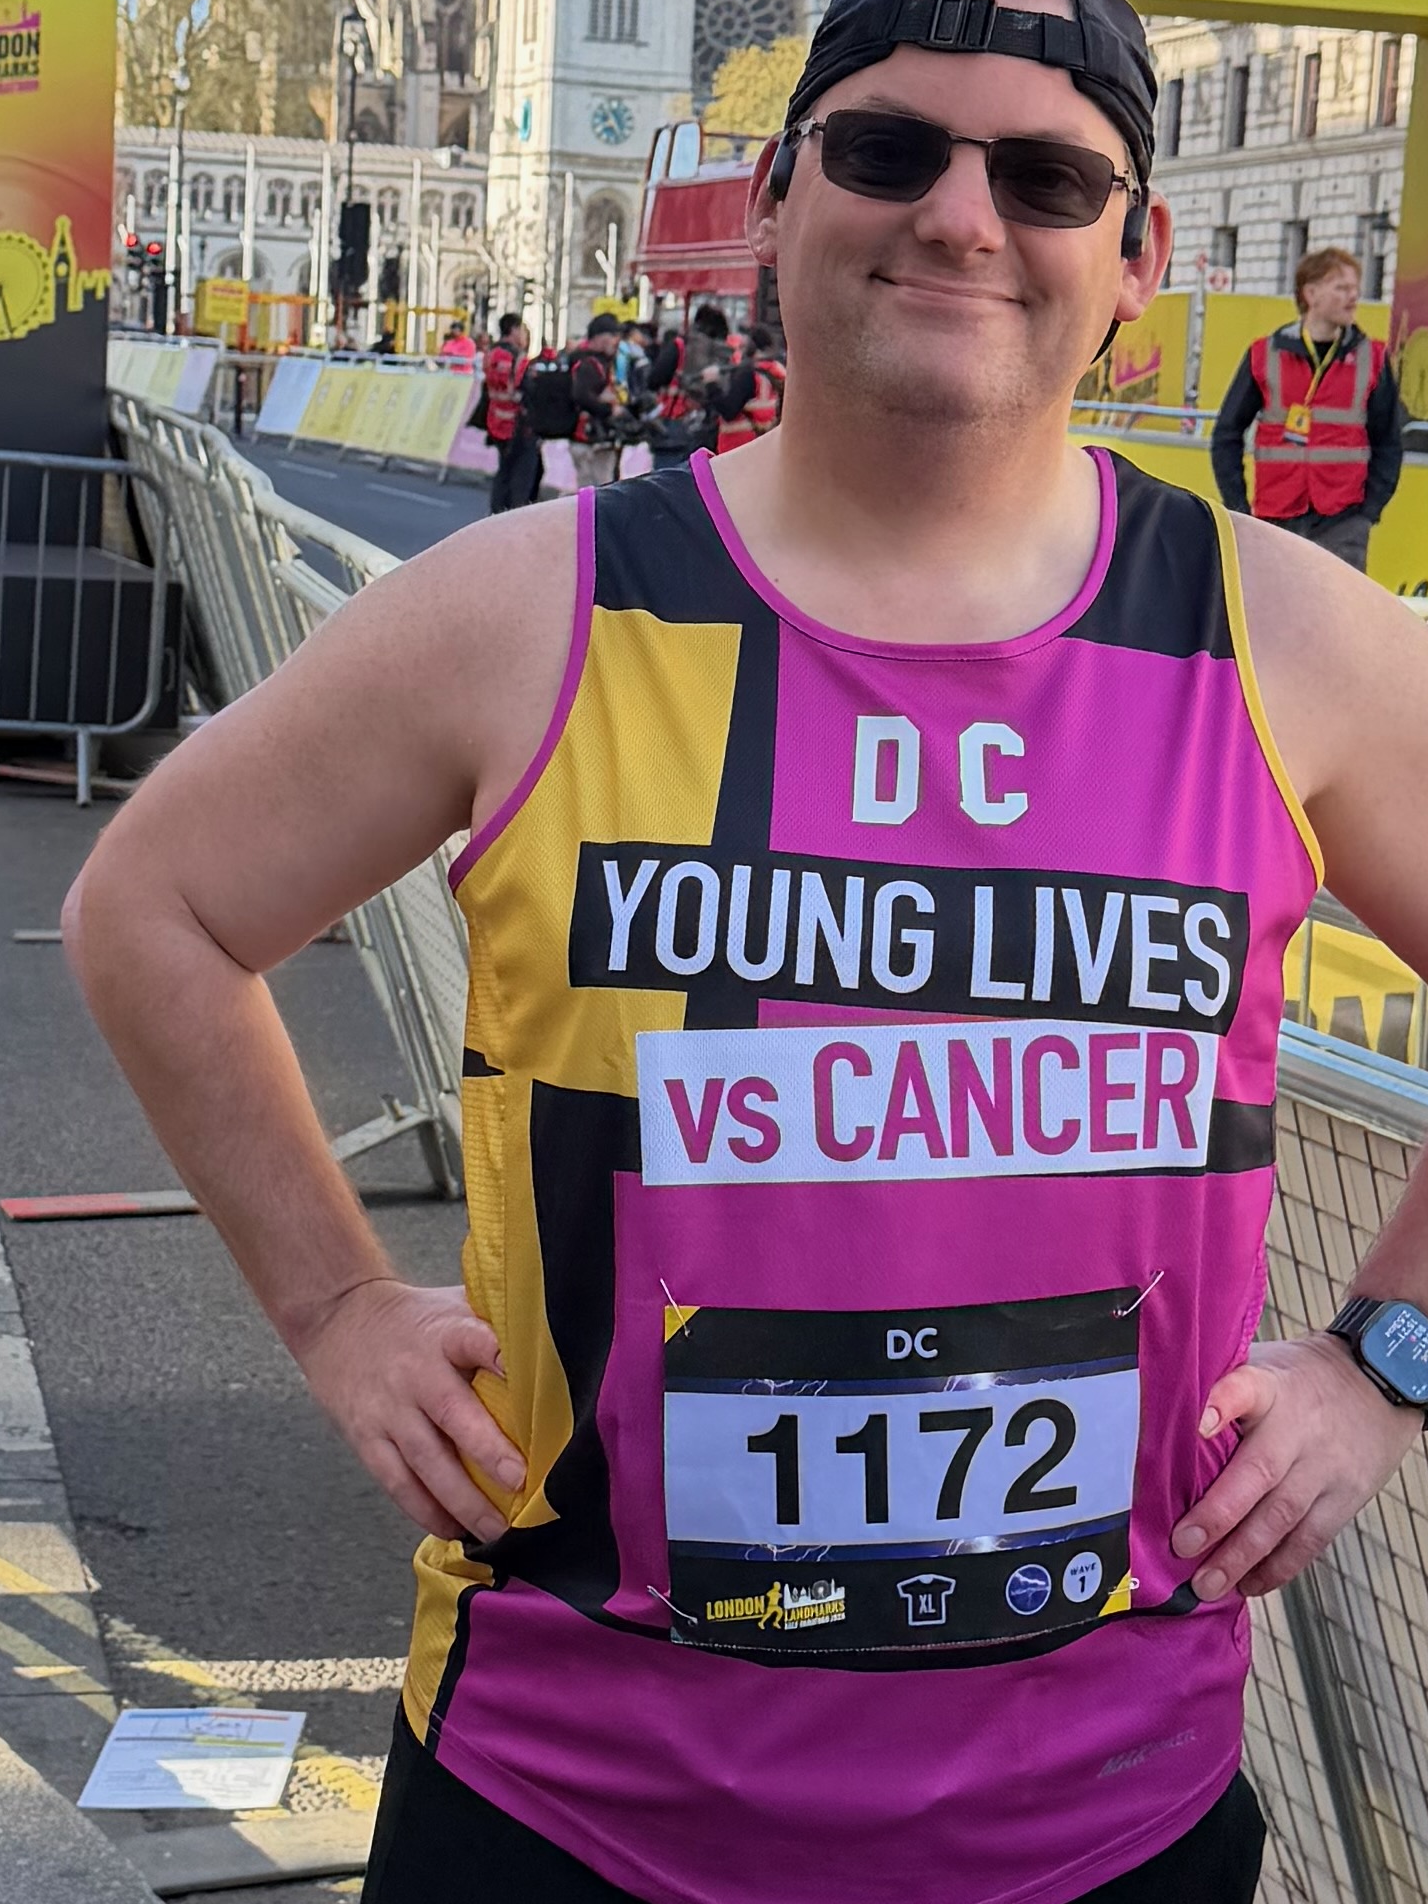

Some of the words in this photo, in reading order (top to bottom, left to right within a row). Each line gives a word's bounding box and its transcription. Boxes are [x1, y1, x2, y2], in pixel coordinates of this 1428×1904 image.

[603, 859, 936, 994] YOUNG
[970, 886, 1231, 1017] LIVES
[812, 1030, 1200, 1164] CANCER
[885, 1327, 938, 1360] DC
[746, 1398, 1079, 1526] 1172
[1070, 1561, 1097, 1576] WAVE
[1078, 1576, 1086, 1593] 1
[706, 1595, 765, 1621] LONDON
[784, 1599, 846, 1623] LANDMARKS
[918, 1594, 936, 1614] XL
